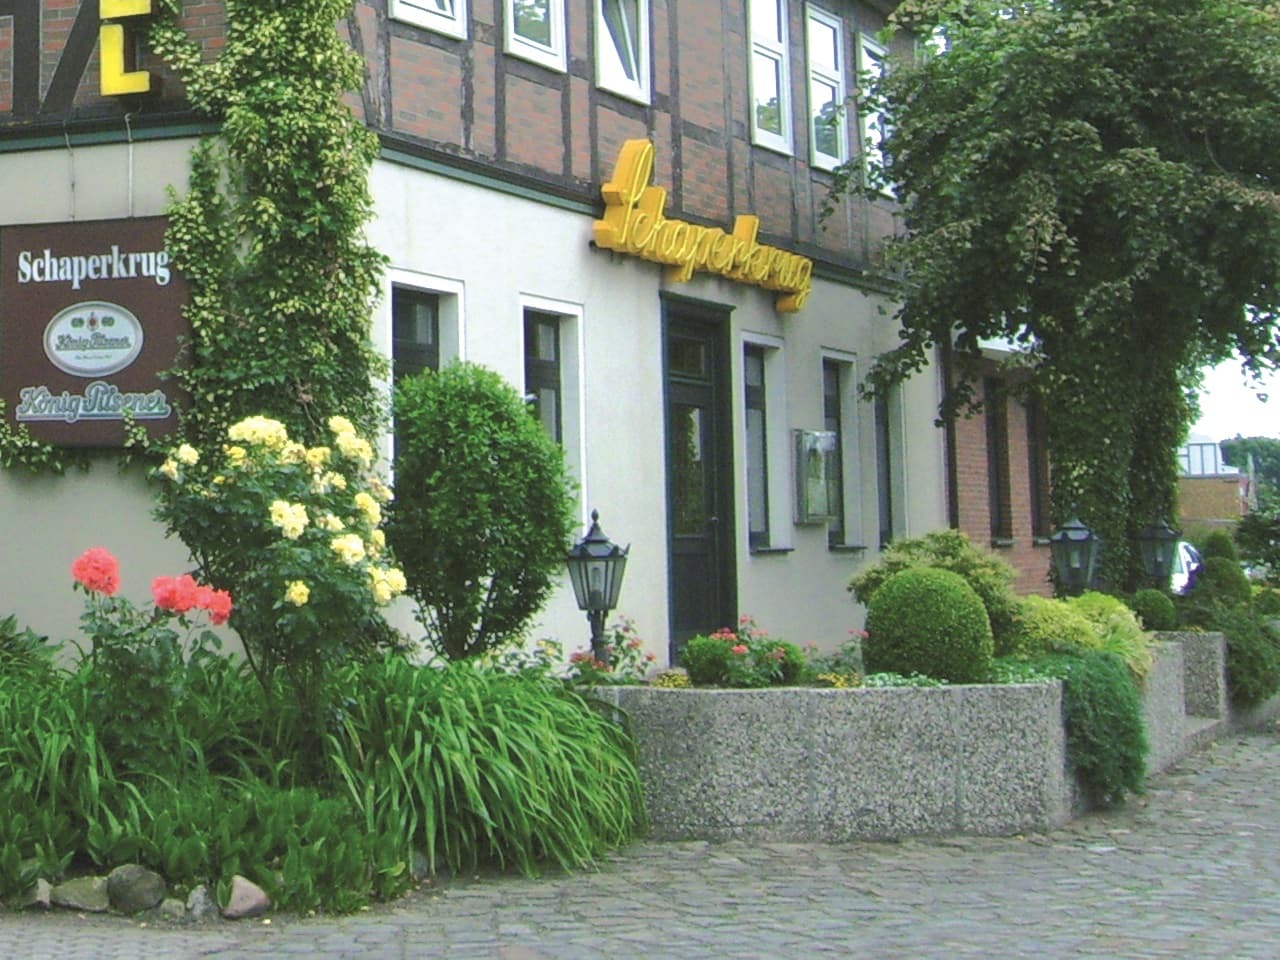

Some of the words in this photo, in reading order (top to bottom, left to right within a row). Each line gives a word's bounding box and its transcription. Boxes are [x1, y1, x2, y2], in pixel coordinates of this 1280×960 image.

[18, 245, 170, 289] Schaperkrug
[19, 387, 81, 421] König
[82, 382, 167, 414] Pilsener
